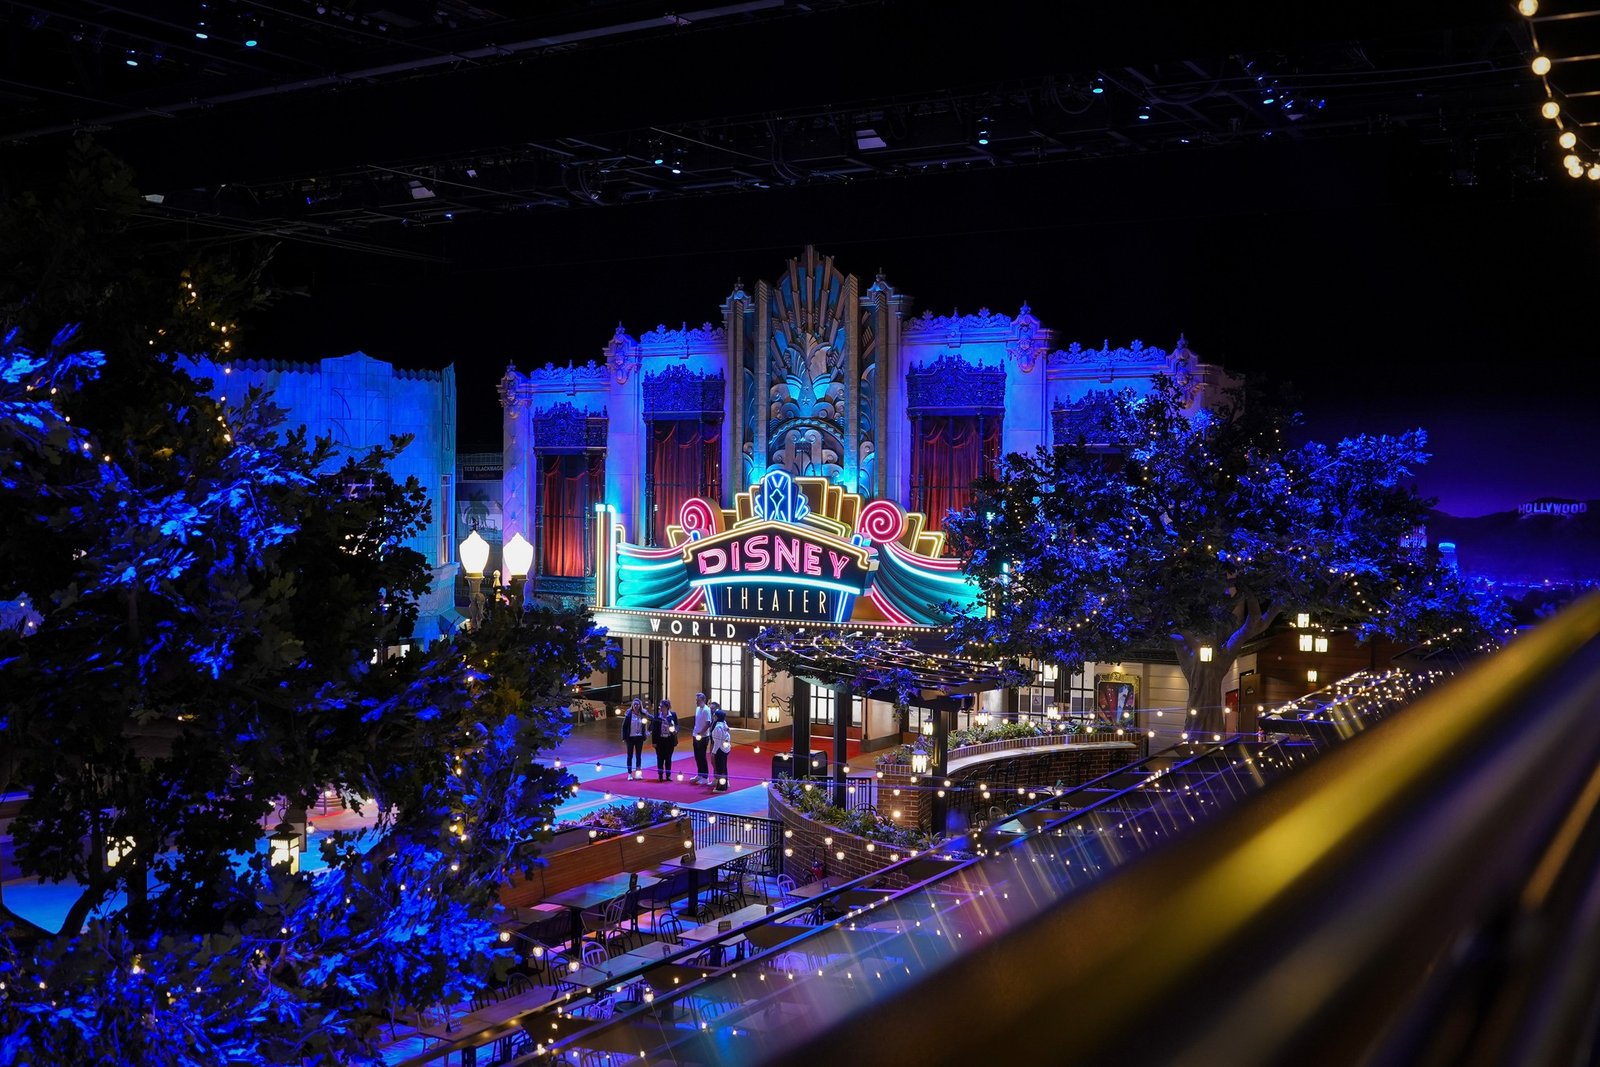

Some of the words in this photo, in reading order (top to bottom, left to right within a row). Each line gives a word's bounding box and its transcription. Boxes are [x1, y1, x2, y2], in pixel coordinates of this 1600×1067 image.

[1518, 502, 1588, 515] HOLLYWOOD
[697, 535, 850, 579] DISNEY
[726, 586, 827, 614] THEATER
[650, 618, 736, 639] WORLD
